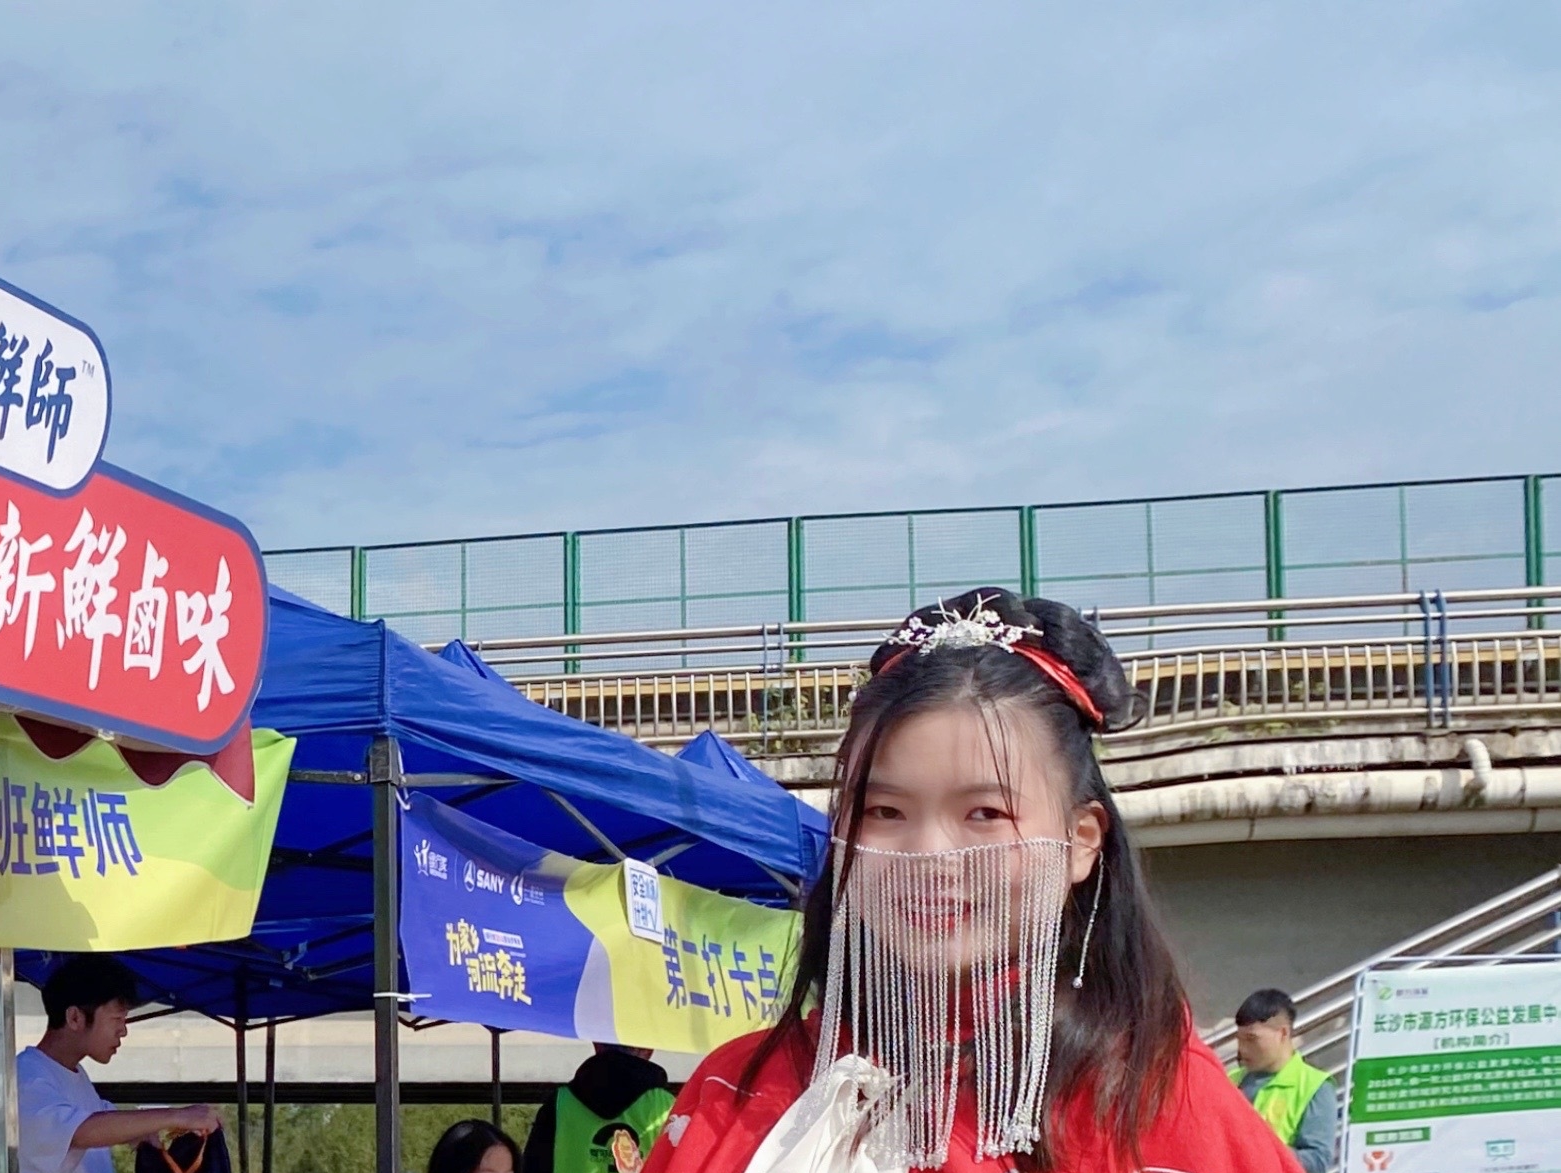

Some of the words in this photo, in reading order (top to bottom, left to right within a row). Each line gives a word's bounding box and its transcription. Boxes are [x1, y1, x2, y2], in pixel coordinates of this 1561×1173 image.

[477, 869, 505, 894] SANY
[465, 948, 532, 1006] 河流奔走
[662, 923, 784, 1020] 第二打卡点
[1374, 1003, 1560, 1033] 长沙市源方环保公益发展中
